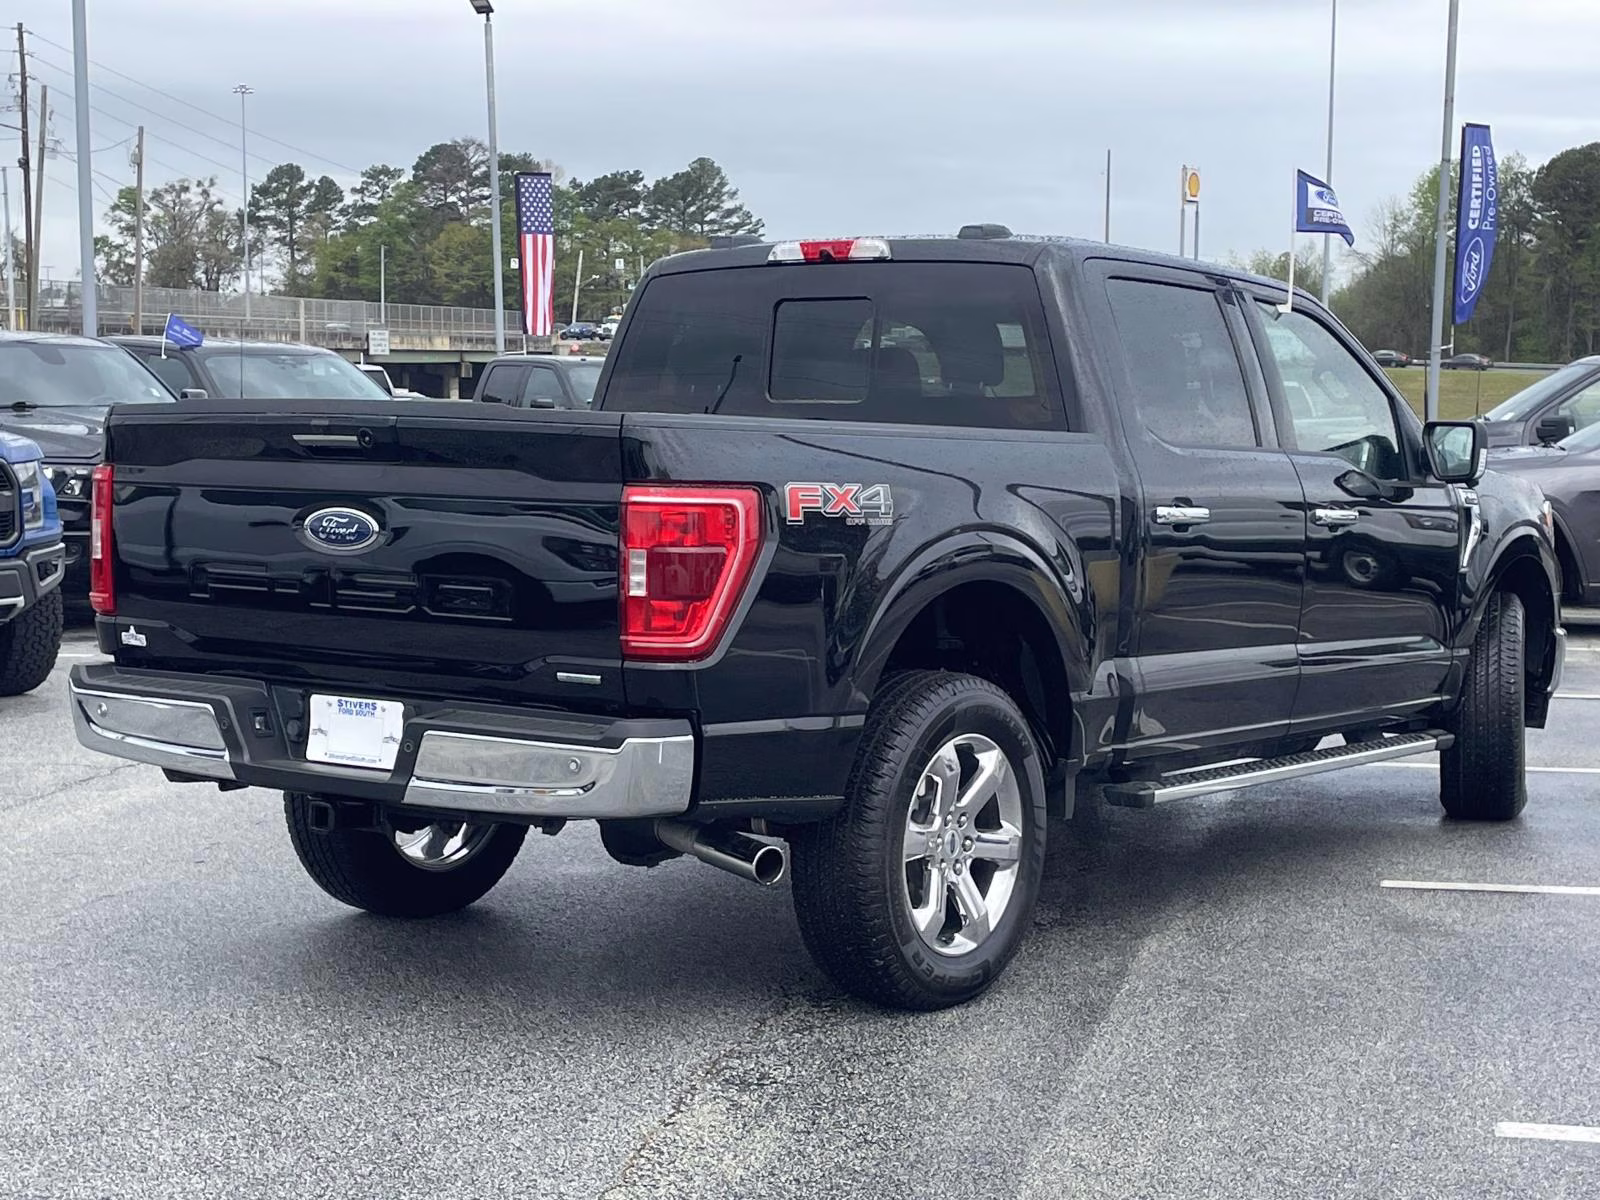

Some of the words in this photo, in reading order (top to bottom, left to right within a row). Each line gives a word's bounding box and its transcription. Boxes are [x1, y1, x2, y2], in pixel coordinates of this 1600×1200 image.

[1468, 145, 1483, 230] CERTIFIED
[1482, 145, 1497, 230] Pre-Owned
[1464, 251, 1480, 291] Ford
[784, 482, 893, 525] FX4
[318, 515, 359, 541] Ford
[337, 698, 378, 711] STIVERS
[338, 707, 354, 715] FORD
